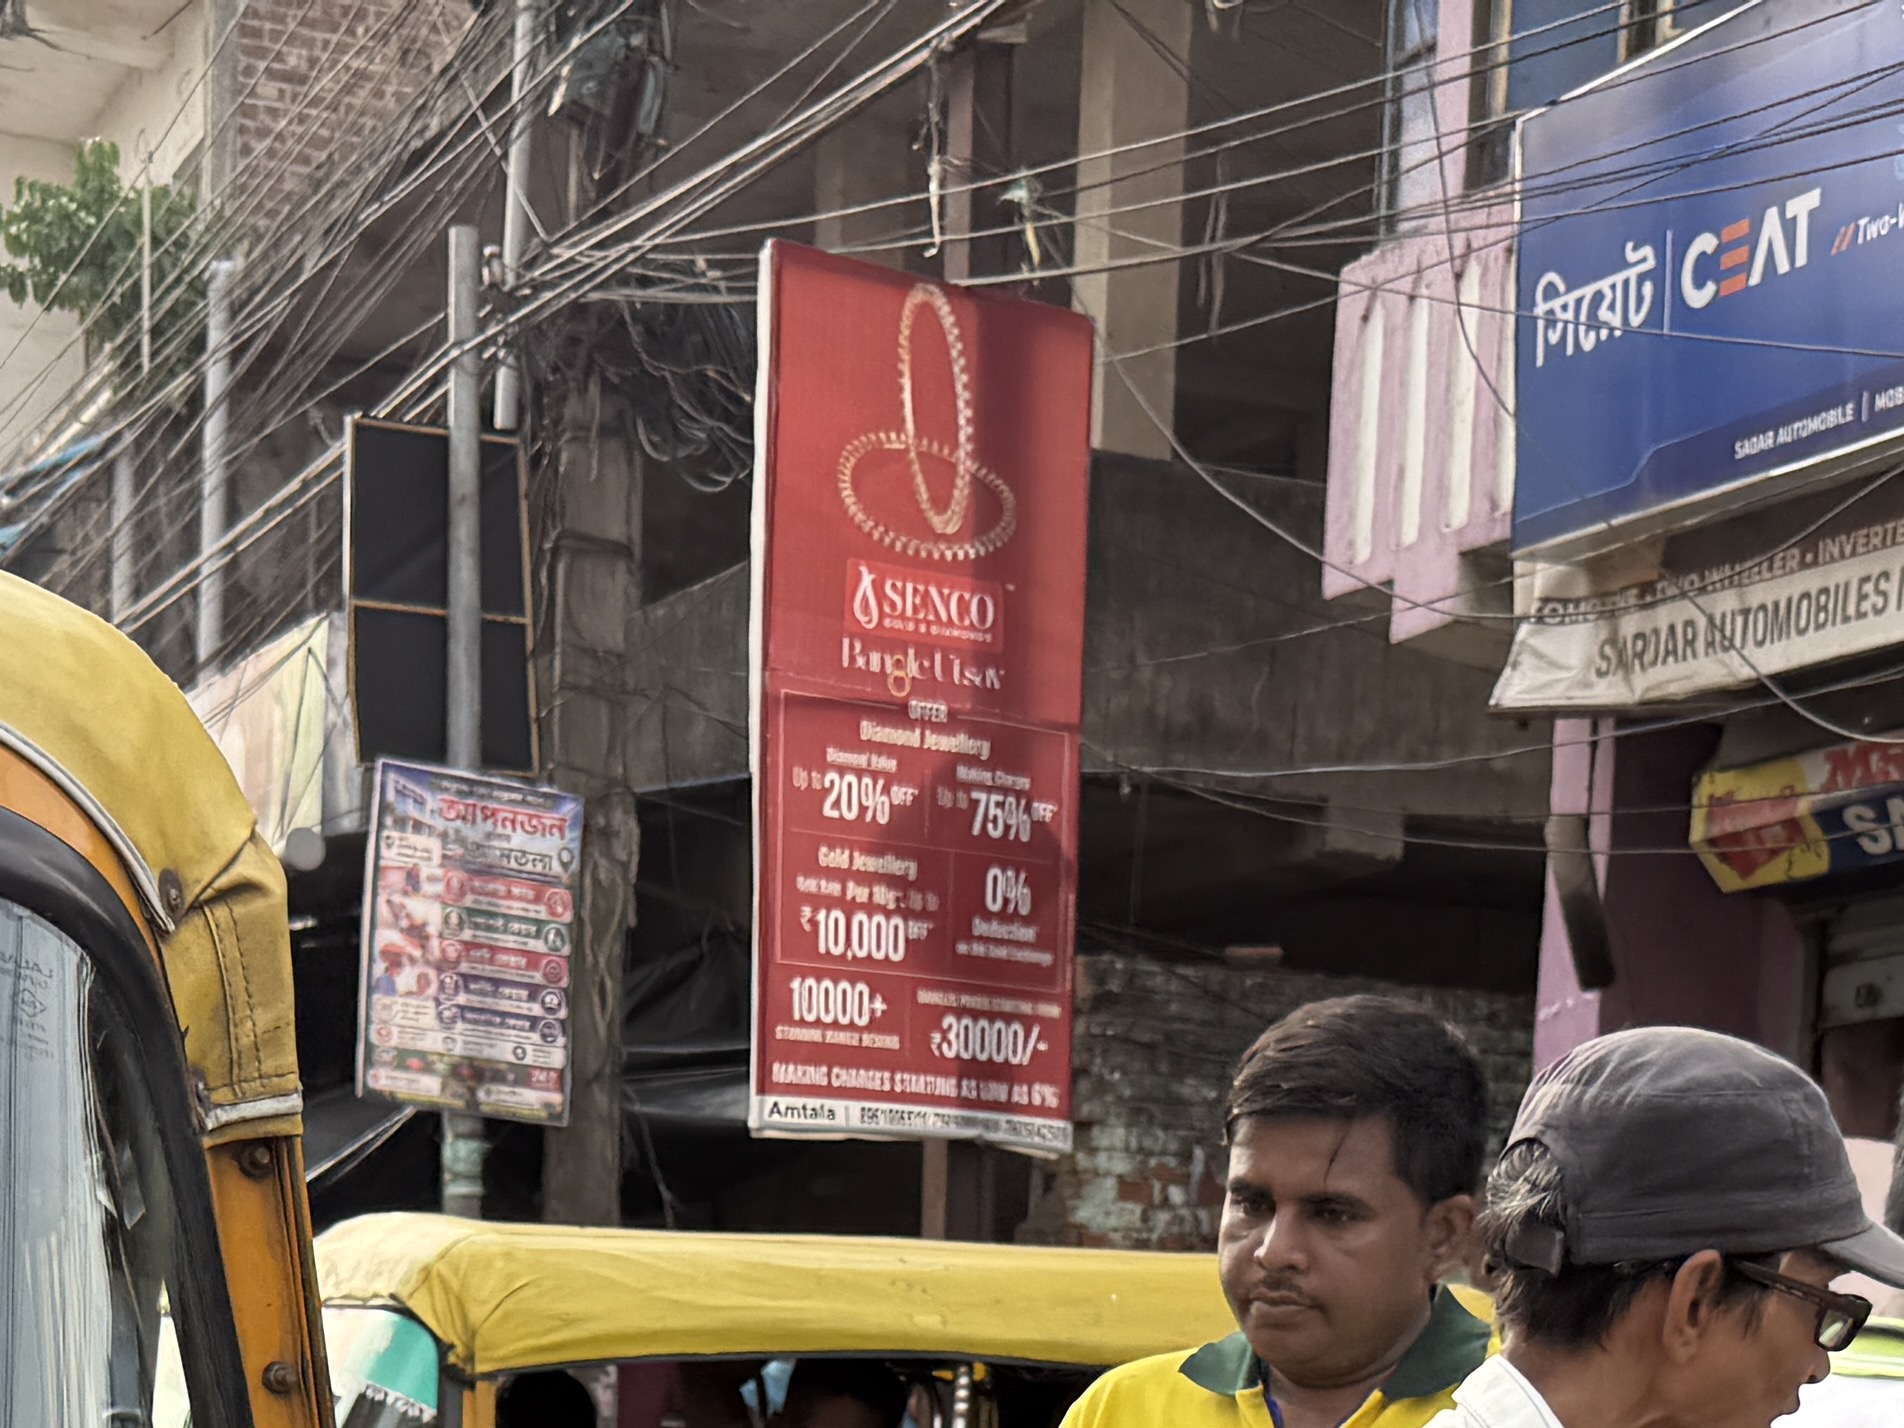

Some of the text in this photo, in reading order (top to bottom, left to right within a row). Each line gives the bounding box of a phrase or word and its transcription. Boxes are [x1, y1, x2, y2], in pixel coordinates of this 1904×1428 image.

[1680, 188, 1823, 309] CEAT
[1533, 241, 1657, 367] সিয়েট
[1776, 403, 1854, 447] AUTOMOBILE
[883, 578, 995, 630] SENCO
[1705, 571, 1890, 661] AUTOMOBILES
[859, 720, 991, 760] Diamond Jewellery
[438, 796, 569, 840] আপনজন
[792, 766, 810, 791] Up
[823, 772, 891, 825] 20%
[970, 790, 1032, 843] 75%
[818, 845, 918, 881] Gold Jewellery
[985, 866, 1032, 917] 0%
[790, 977, 887, 1027] 10000+
[772, 1061, 829, 1086] MAKING
[768, 1101, 837, 1121] Amtala
